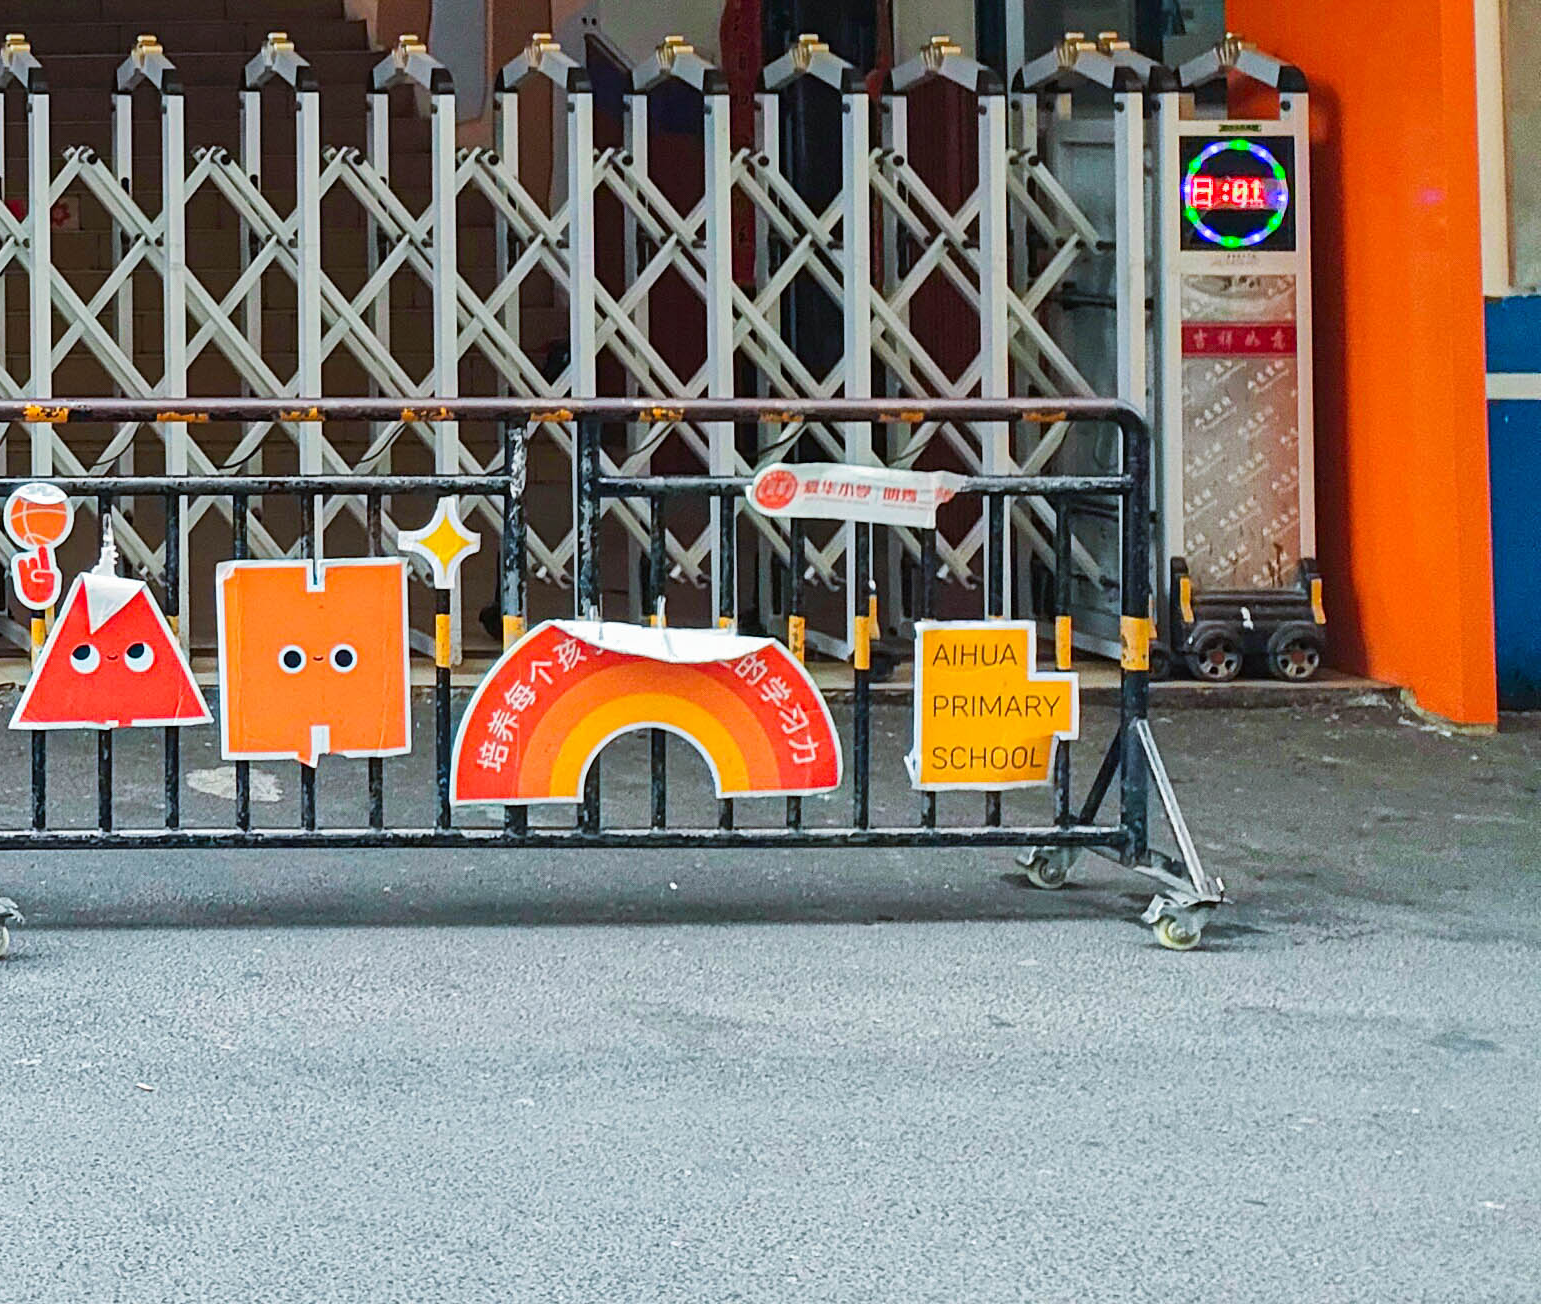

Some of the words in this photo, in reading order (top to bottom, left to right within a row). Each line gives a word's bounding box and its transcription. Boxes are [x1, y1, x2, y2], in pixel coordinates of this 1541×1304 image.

[1193, 328, 1286, 351] 吉祥如意
[932, 643, 1017, 667] AIHUA
[932, 695, 1060, 718] PRIMARY
[932, 746, 1043, 771] SCHOOL
